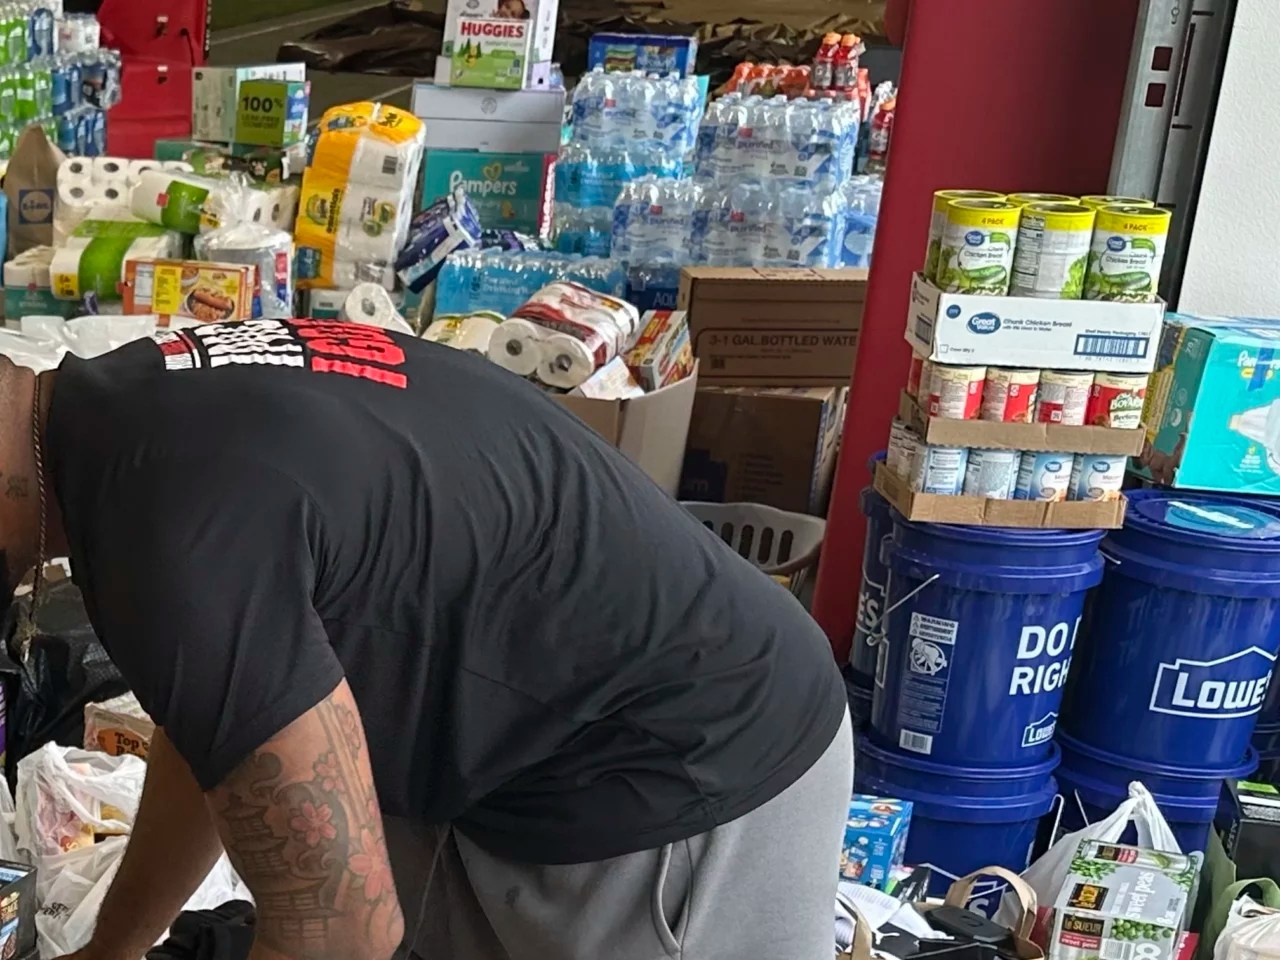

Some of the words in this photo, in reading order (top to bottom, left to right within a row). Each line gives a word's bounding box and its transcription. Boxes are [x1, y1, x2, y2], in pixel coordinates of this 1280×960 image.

[461, 22, 524, 38] HUGGIES
[449, 170, 518, 197] Pampers
[971, 316, 997, 327] Great
[1025, 319, 1052, 327] Chicken
[1052, 320, 1073, 328] Breast
[761, 335, 819, 346] BOTTLED
[822, 335, 857, 346] WATE
[920, 616, 956, 628] WARNING
[1016, 622, 1069, 660] DO
[1009, 658, 1071, 696] RIGH
[114, 732, 140, 749] Top
[1061, 937, 1080, 946] sweet
[1082, 941, 1099, 950] peas
